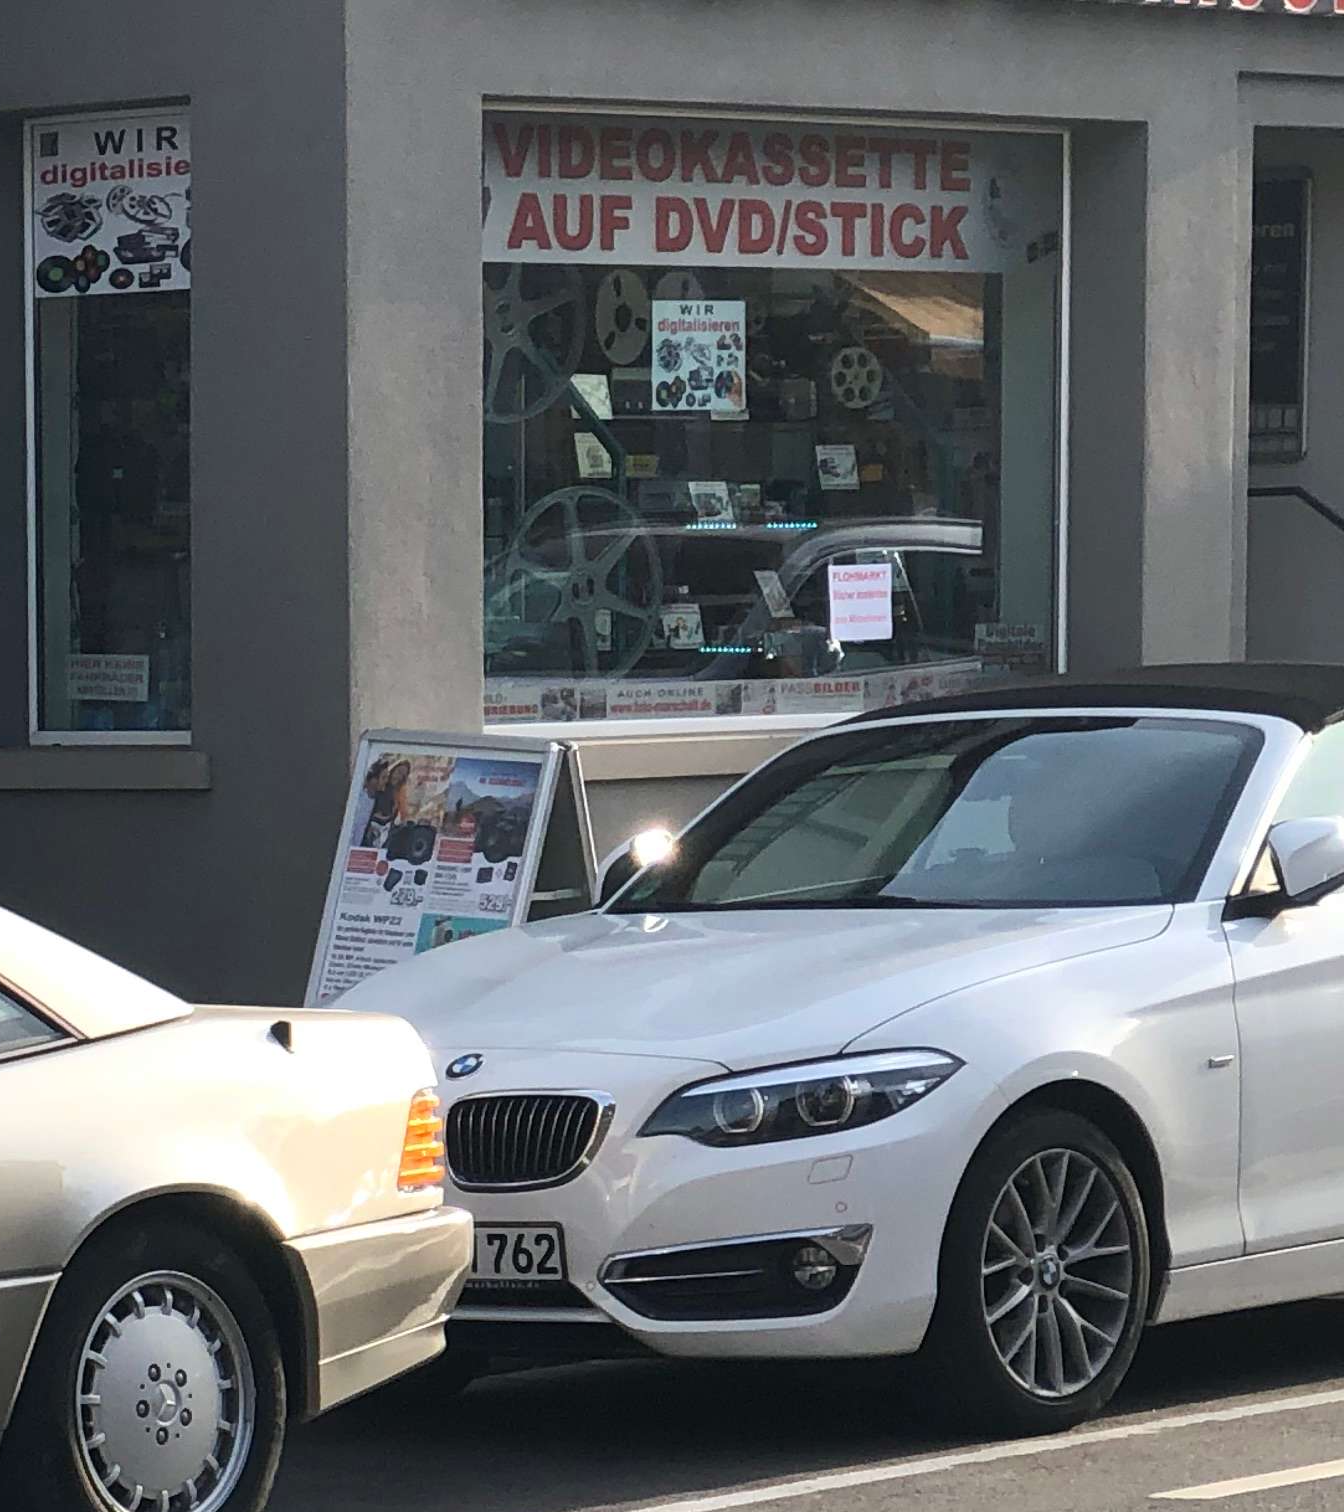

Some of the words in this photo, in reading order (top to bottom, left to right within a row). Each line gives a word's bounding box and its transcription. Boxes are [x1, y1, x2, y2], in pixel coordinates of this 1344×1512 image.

[94, 126, 179, 156] WIR
[492, 123, 972, 193] VIDEOKASSETTE
[506, 193, 633, 250] AUF
[654, 195, 970, 260] DVD/STICK
[679, 304, 714, 316] WIR
[339, 912, 372, 923] Kodak
